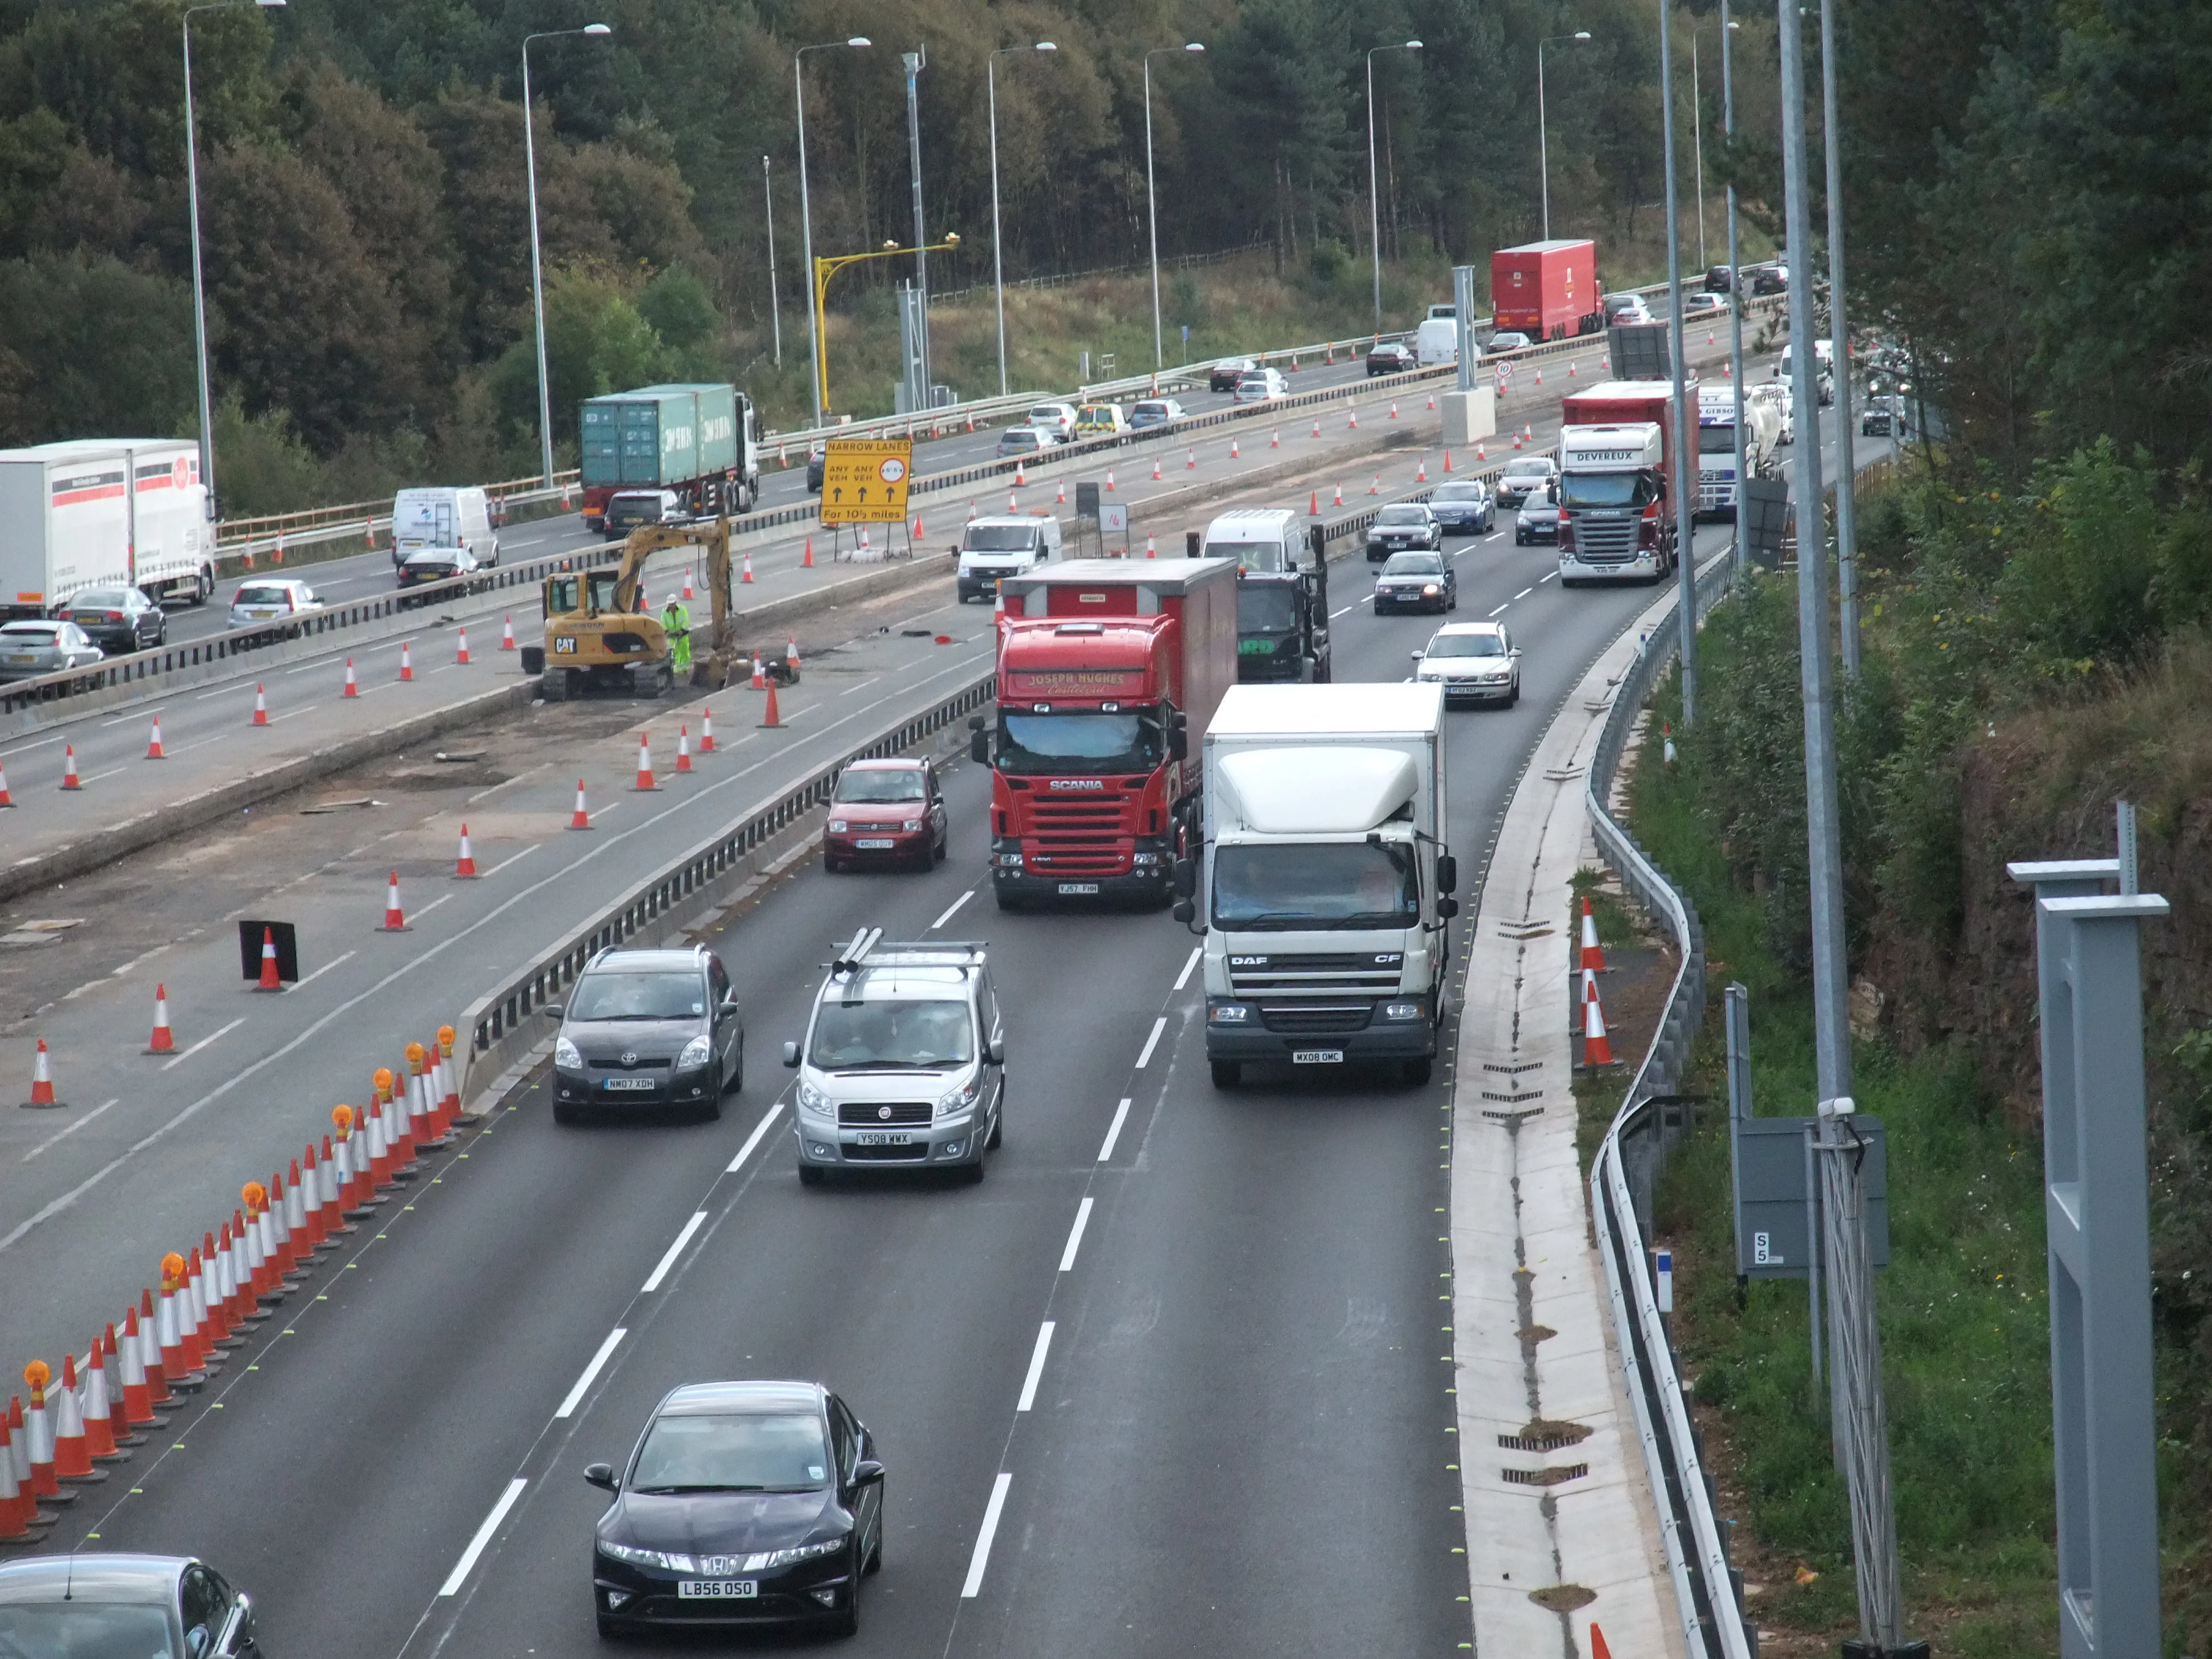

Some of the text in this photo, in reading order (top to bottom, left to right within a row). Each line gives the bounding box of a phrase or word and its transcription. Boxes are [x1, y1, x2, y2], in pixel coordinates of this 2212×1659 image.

[828, 442, 910, 451] NARROW LANES
[1577, 451, 1632, 461] DEVEREUX
[824, 510, 841, 519] For
[872, 510, 900, 518] miles
[556, 638, 575, 653] CAT
[1029, 672, 1125, 687] JOSEPH HUGHES
[1050, 780, 1104, 790] SCANIA
[1232, 956, 1268, 965] DAF
[1375, 954, 1401, 963] CF
[1297, 1053, 1320, 1062] MX08
[610, 1079, 633, 1088] NM07
[861, 1135, 886, 1144] YS08
[1757, 1235, 1766, 1246] S
[1758, 1250, 1766, 1261] 5
[685, 1583, 720, 1595] LB56
